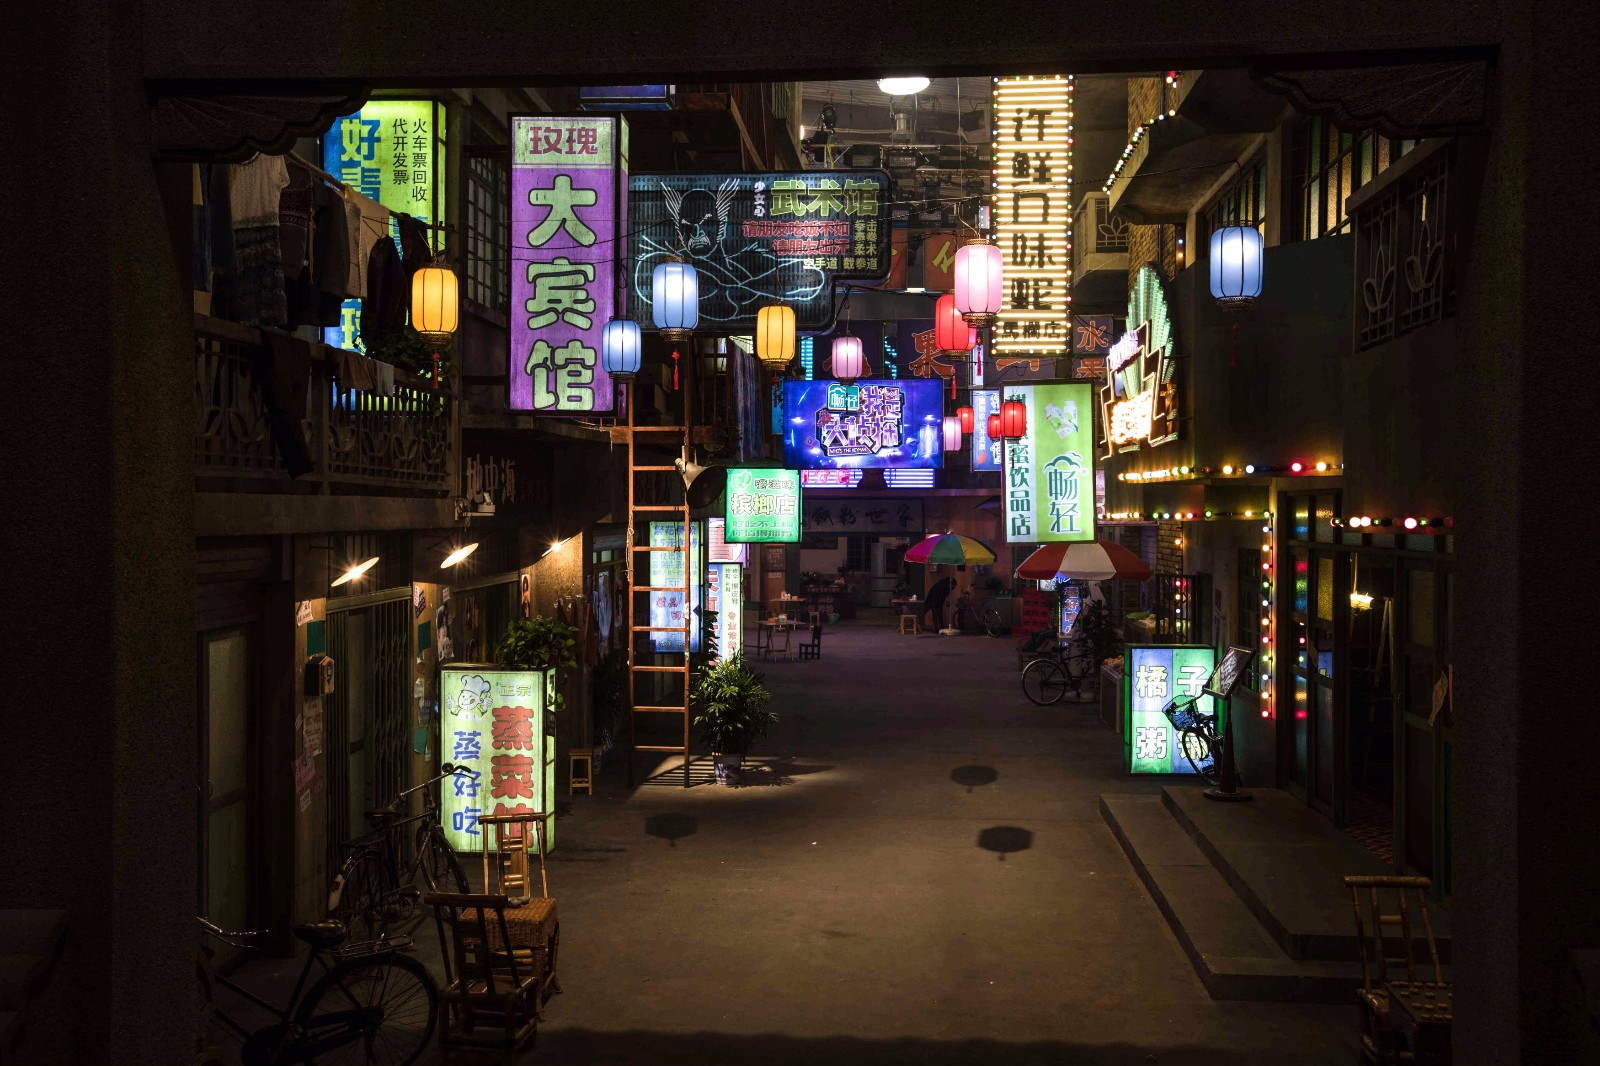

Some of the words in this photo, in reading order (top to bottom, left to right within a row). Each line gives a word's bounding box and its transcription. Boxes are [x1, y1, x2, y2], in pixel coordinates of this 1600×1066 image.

[392, 118, 408, 186] 代开发票
[529, 126, 598, 155] 玫瑰
[412, 118, 428, 202] 火车票回收
[753, 180, 766, 217] 少女心
[769, 178, 880, 217] 武术馆
[742, 220, 850, 237] 请朋友吃饭不如
[771, 239, 850, 255] 请朋友出汗
[803, 257, 838, 270] 空手道
[525, 174, 598, 411] 大宾馆
[730, 493, 796, 516] 槟榔店
[1048, 468, 1082, 533] 畅轻
[498, 684, 532, 698] 正宗
[1135, 664, 1209, 699] 橘子
[452, 730, 482, 836] 蒸好吃
[490, 705, 535, 849] 蒸菜馆
